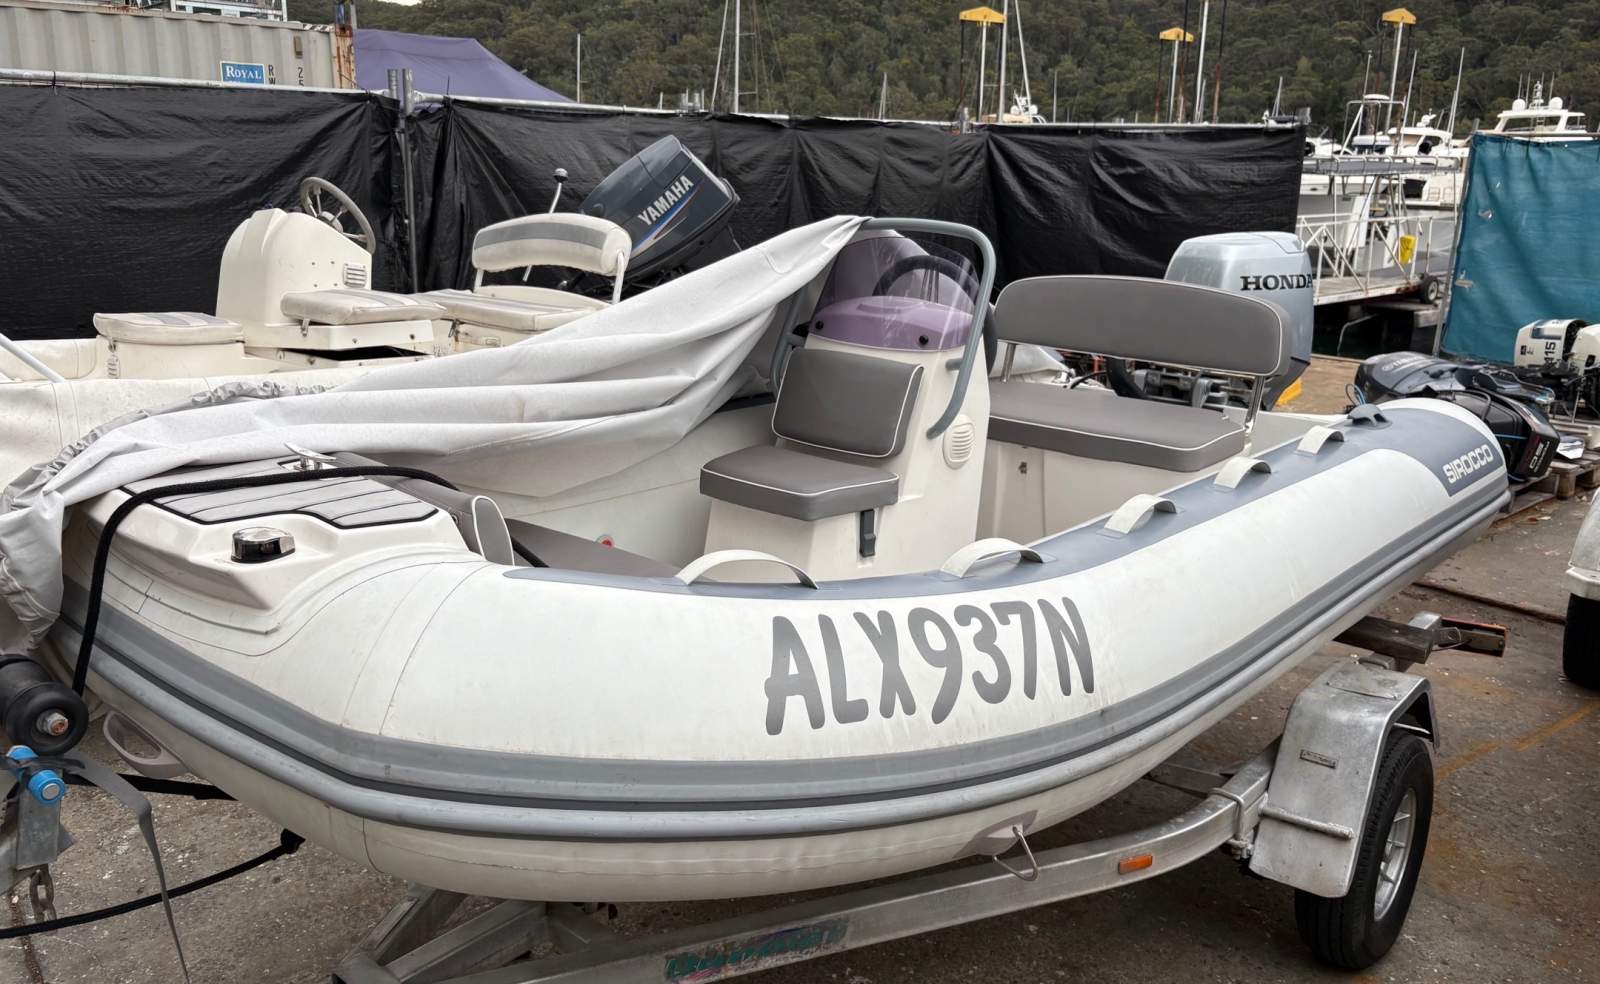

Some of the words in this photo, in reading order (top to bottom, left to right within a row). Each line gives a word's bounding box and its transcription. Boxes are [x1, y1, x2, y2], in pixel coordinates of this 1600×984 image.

[226, 65, 262, 80] ROYAL
[637, 175, 694, 226] YAMAHA
[1240, 273, 1313, 291] HONDA
[1442, 444, 1494, 484] SIROCCO
[764, 596, 1094, 735] ALX937N
